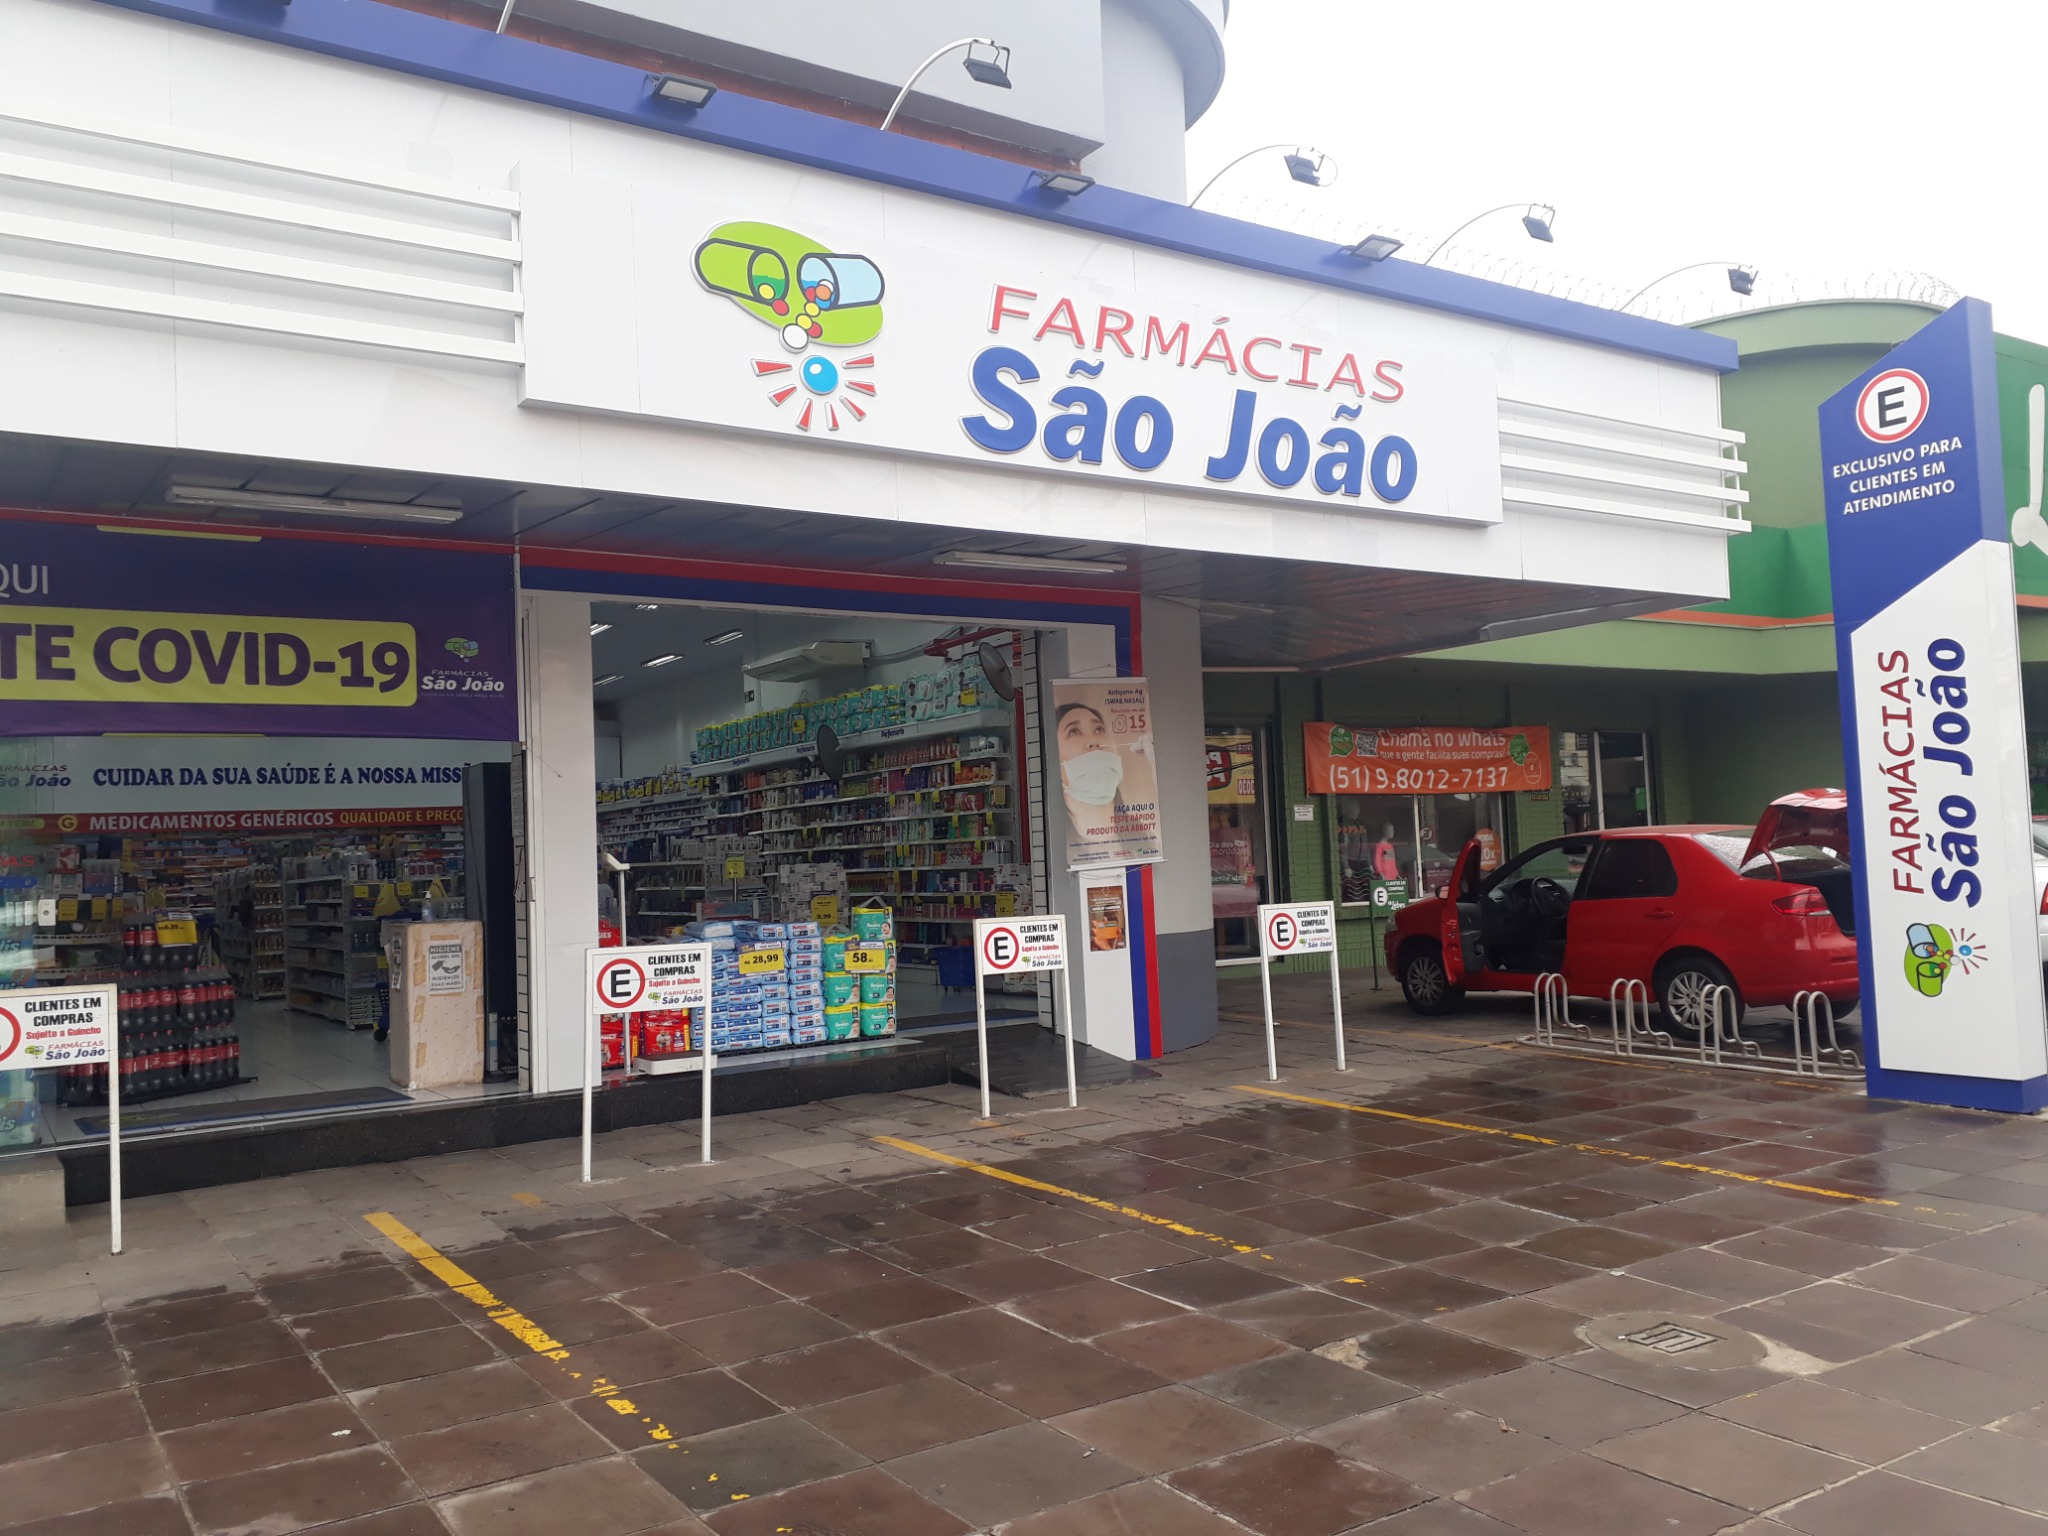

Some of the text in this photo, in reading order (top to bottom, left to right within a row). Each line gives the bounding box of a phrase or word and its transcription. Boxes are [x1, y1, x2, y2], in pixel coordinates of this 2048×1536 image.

[987, 283, 1405, 402] FARMÁCIAS
[1877, 386, 1907, 428] E
[959, 344, 1418, 503] São João
[1832, 436, 1962, 478] EXCLUSIVO PARA
[1849, 460, 1946, 494] CLIENTES EM
[1843, 479, 1955, 515] ATENDIMENTO
[93, 625, 410, 693] COVID-19
[431, 669, 488, 677] FARMÁCIAS
[421, 675, 504, 691] São João
[1129, 715, 1146, 728] 15
[1379, 730, 1506, 747] Chama no whats
[1380, 751, 1394, 760] que
[1402, 751, 1424, 761] gente
[1426, 749, 1451, 759] facilita
[93, 768, 174, 786] CUIDAR
[179, 768, 208, 786] DA
[212, 767, 252, 785] SUA
[256, 762, 320, 784] SAÚDE
[324, 762, 336, 784] É
[340, 767, 353, 784] A
[357, 767, 417, 784] NOSSA
[1877, 649, 1925, 894] FARMÁCIAS
[1914, 637, 1982, 908] São João
[26, 774, 71, 787] João
[1329, 765, 1508, 792] (51) 9.8012-7137
[1114, 805, 1130, 814] FAÇA
[1131, 803, 1148, 812] AQUI
[89, 813, 236, 830] MEDICAMENTOS
[240, 810, 334, 827] GENÉRICOS
[340, 810, 412, 824] QUALIDADE
[416, 810, 422, 821] E
[1110, 813, 1155, 823] TESTE RÁPIDO
[1086, 823, 1156, 836] PRODUTO DA ABBOTT
[1377, 891, 1384, 903] E
[1020, 924, 1058, 933] CLIENTES EM
[1301, 919, 1326, 927] COMPRAS
[1277, 921, 1289, 942] E
[1025, 934, 1055, 943] COMPRAS
[994, 936, 1010, 960] E
[648, 953, 701, 965] CLIENTES EM
[753, 954, 778, 964] 28,99
[852, 953, 868, 962] 58
[1046, 958, 1062, 966] João
[654, 965, 695, 977] COMPRAS
[611, 969, 631, 998] E
[648, 979, 670, 988] Sujeito
[677, 977, 700, 985] Guincho
[25, 997, 101, 1013] CLIENTES EM
[662, 994, 703, 1004] São João
[33, 1012, 93, 1026] COMPRAS
[26, 1030, 57, 1040] Sujeito
[67, 1027, 101, 1036] Guincho
[48, 1040, 104, 1050] FARMÁCIAS
[45, 1047, 105, 1060] São João
